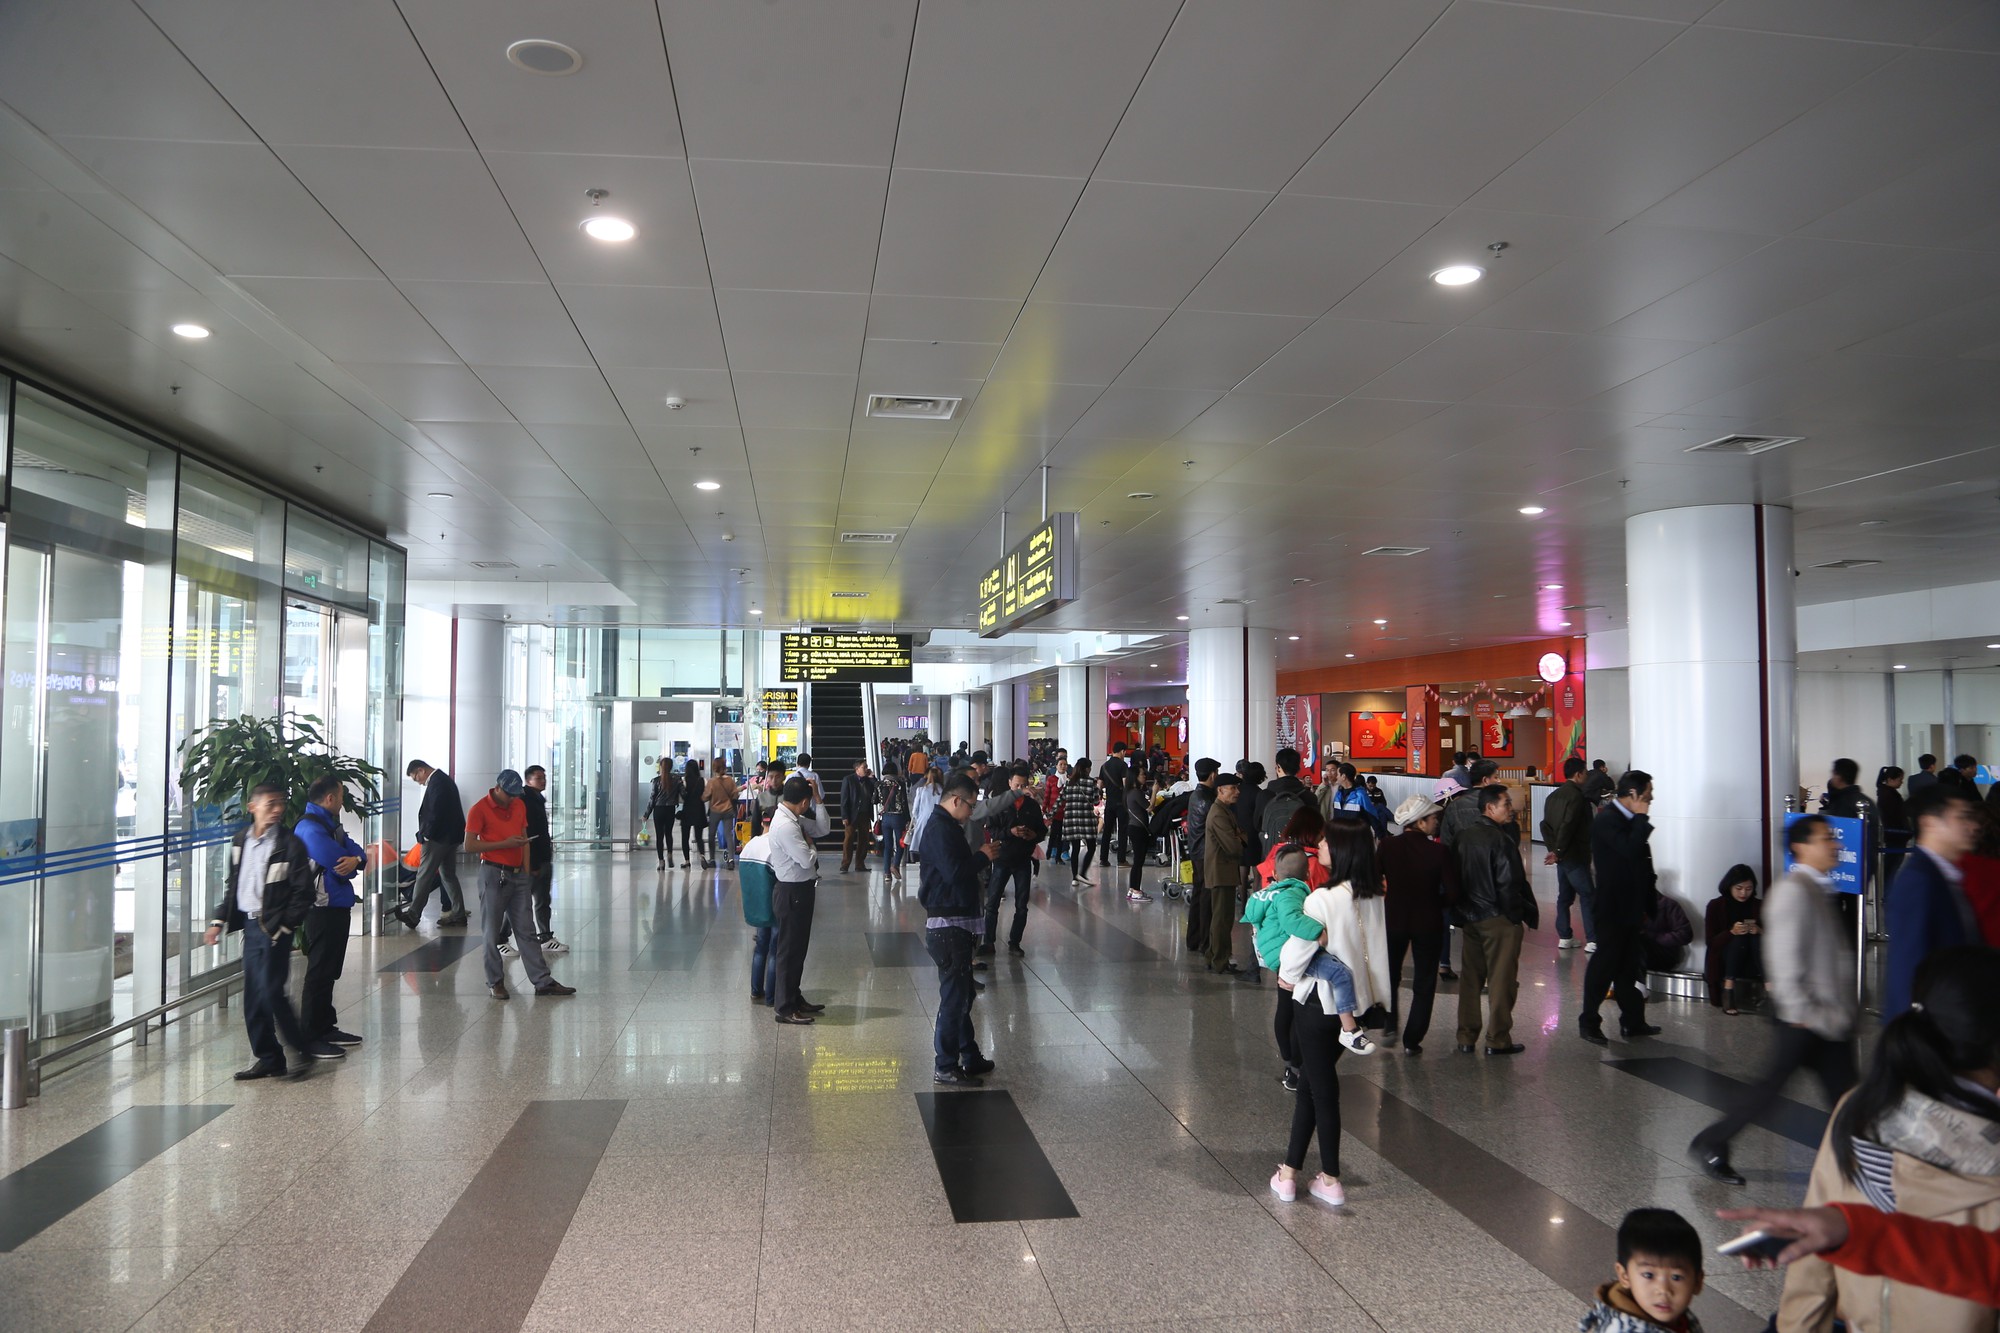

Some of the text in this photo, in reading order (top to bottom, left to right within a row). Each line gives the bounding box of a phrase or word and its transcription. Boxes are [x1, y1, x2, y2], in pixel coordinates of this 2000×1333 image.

[1006, 554, 1015, 589] A1
[801, 637, 808, 646] 3
[801, 653, 808, 662] 2
[802, 669, 808, 679] 1
